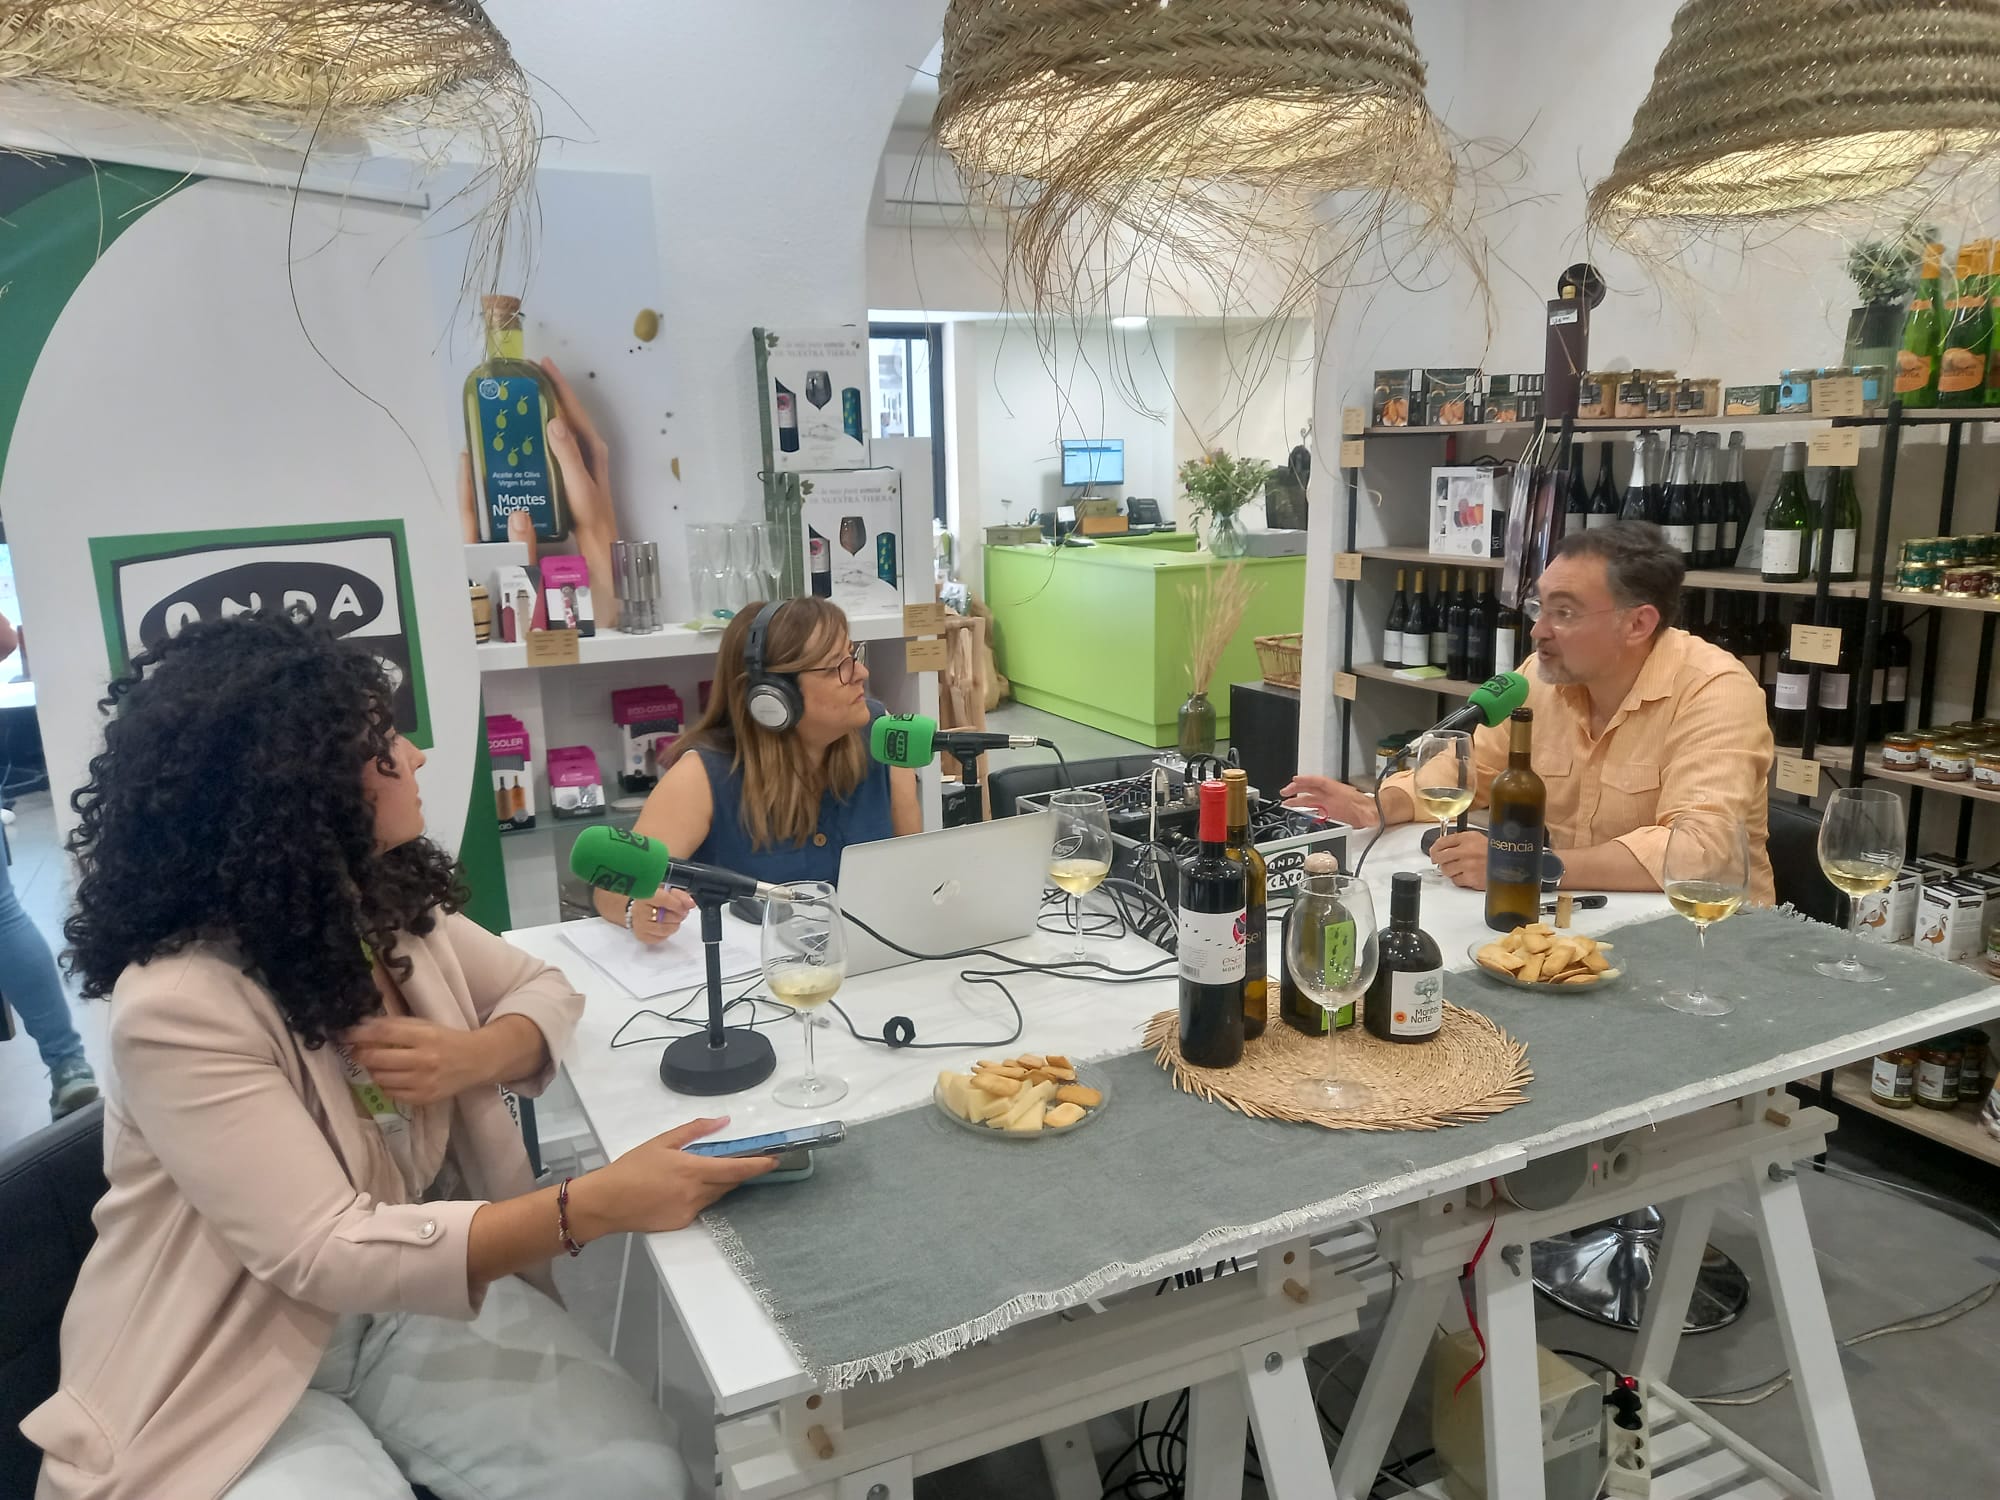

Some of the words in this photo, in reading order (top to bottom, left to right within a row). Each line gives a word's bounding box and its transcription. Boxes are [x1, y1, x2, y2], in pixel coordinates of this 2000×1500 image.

[498, 480, 519, 488] Virgen
[520, 479, 536, 487] Extra
[498, 493, 546, 506] Montes
[164, 583, 364, 640] ONDA
[1490, 838, 1534, 853] esencia
[1268, 855, 1303, 871] ONDA
[1270, 872, 1303, 889] CERO
[1410, 1015, 1433, 1024] Norte
